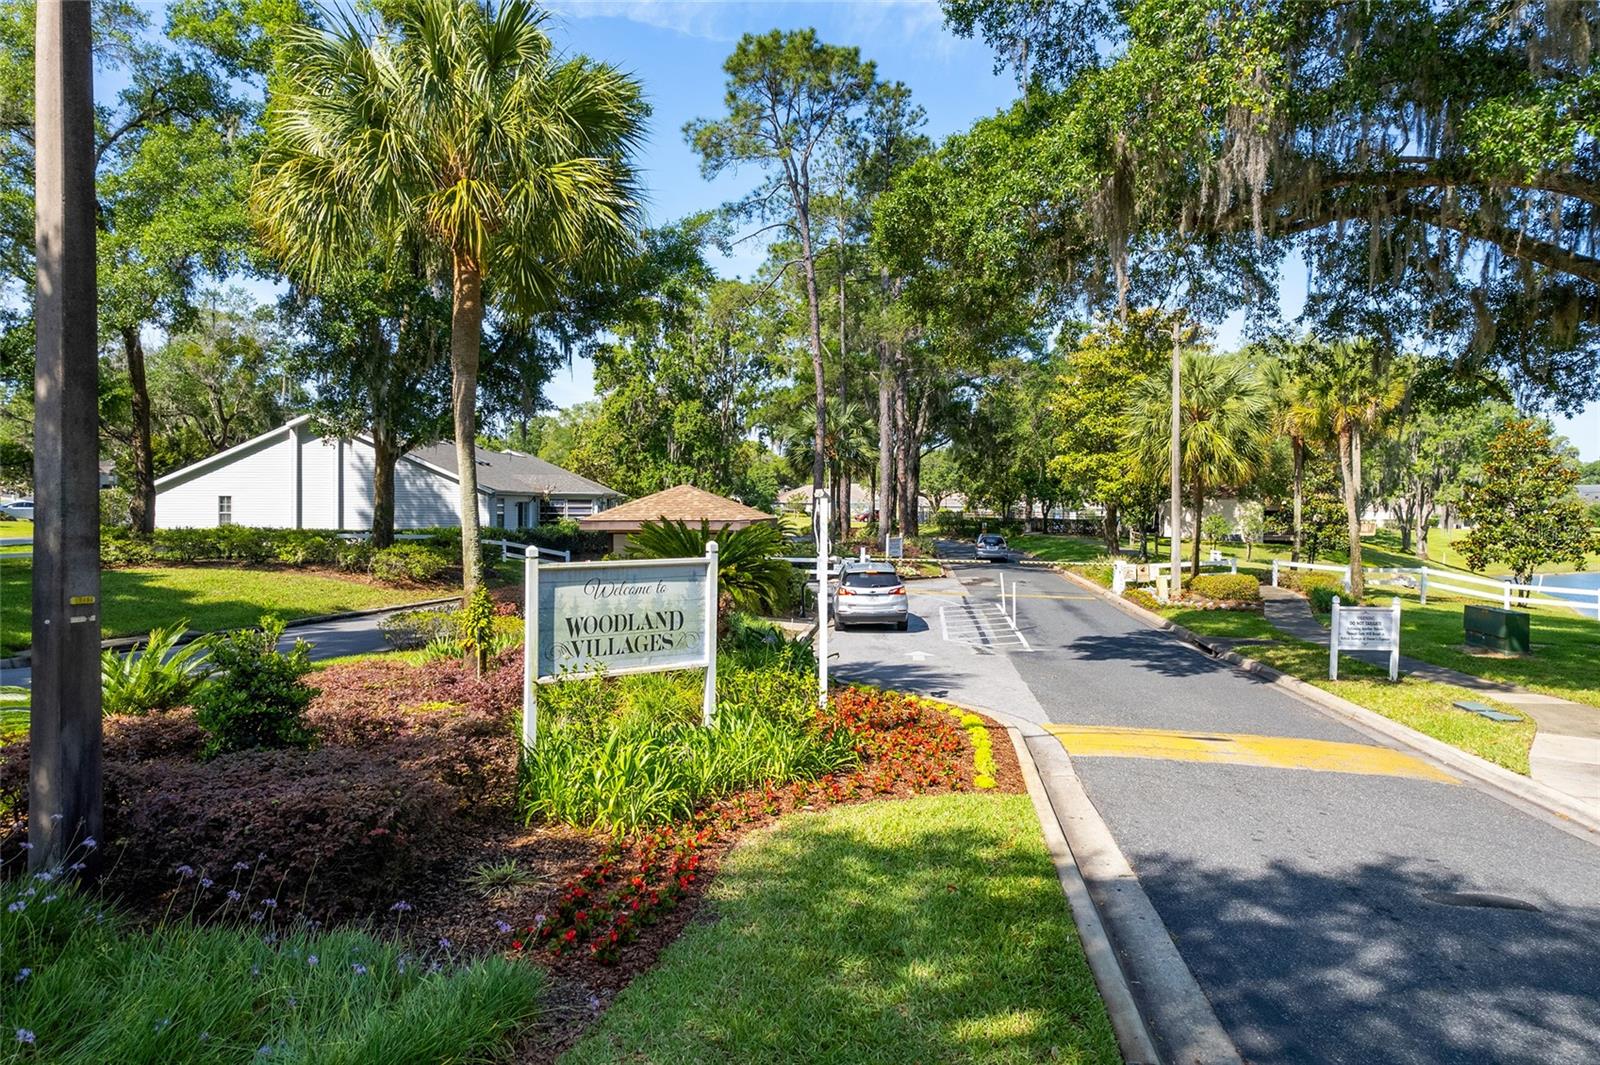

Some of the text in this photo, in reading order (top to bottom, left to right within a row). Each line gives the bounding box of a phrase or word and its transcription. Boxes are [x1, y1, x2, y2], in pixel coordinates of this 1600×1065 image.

[583, 577, 667, 600] Welcome to
[565, 610, 684, 639] WOODLAND
[570, 633, 674, 658] VILLAGES
